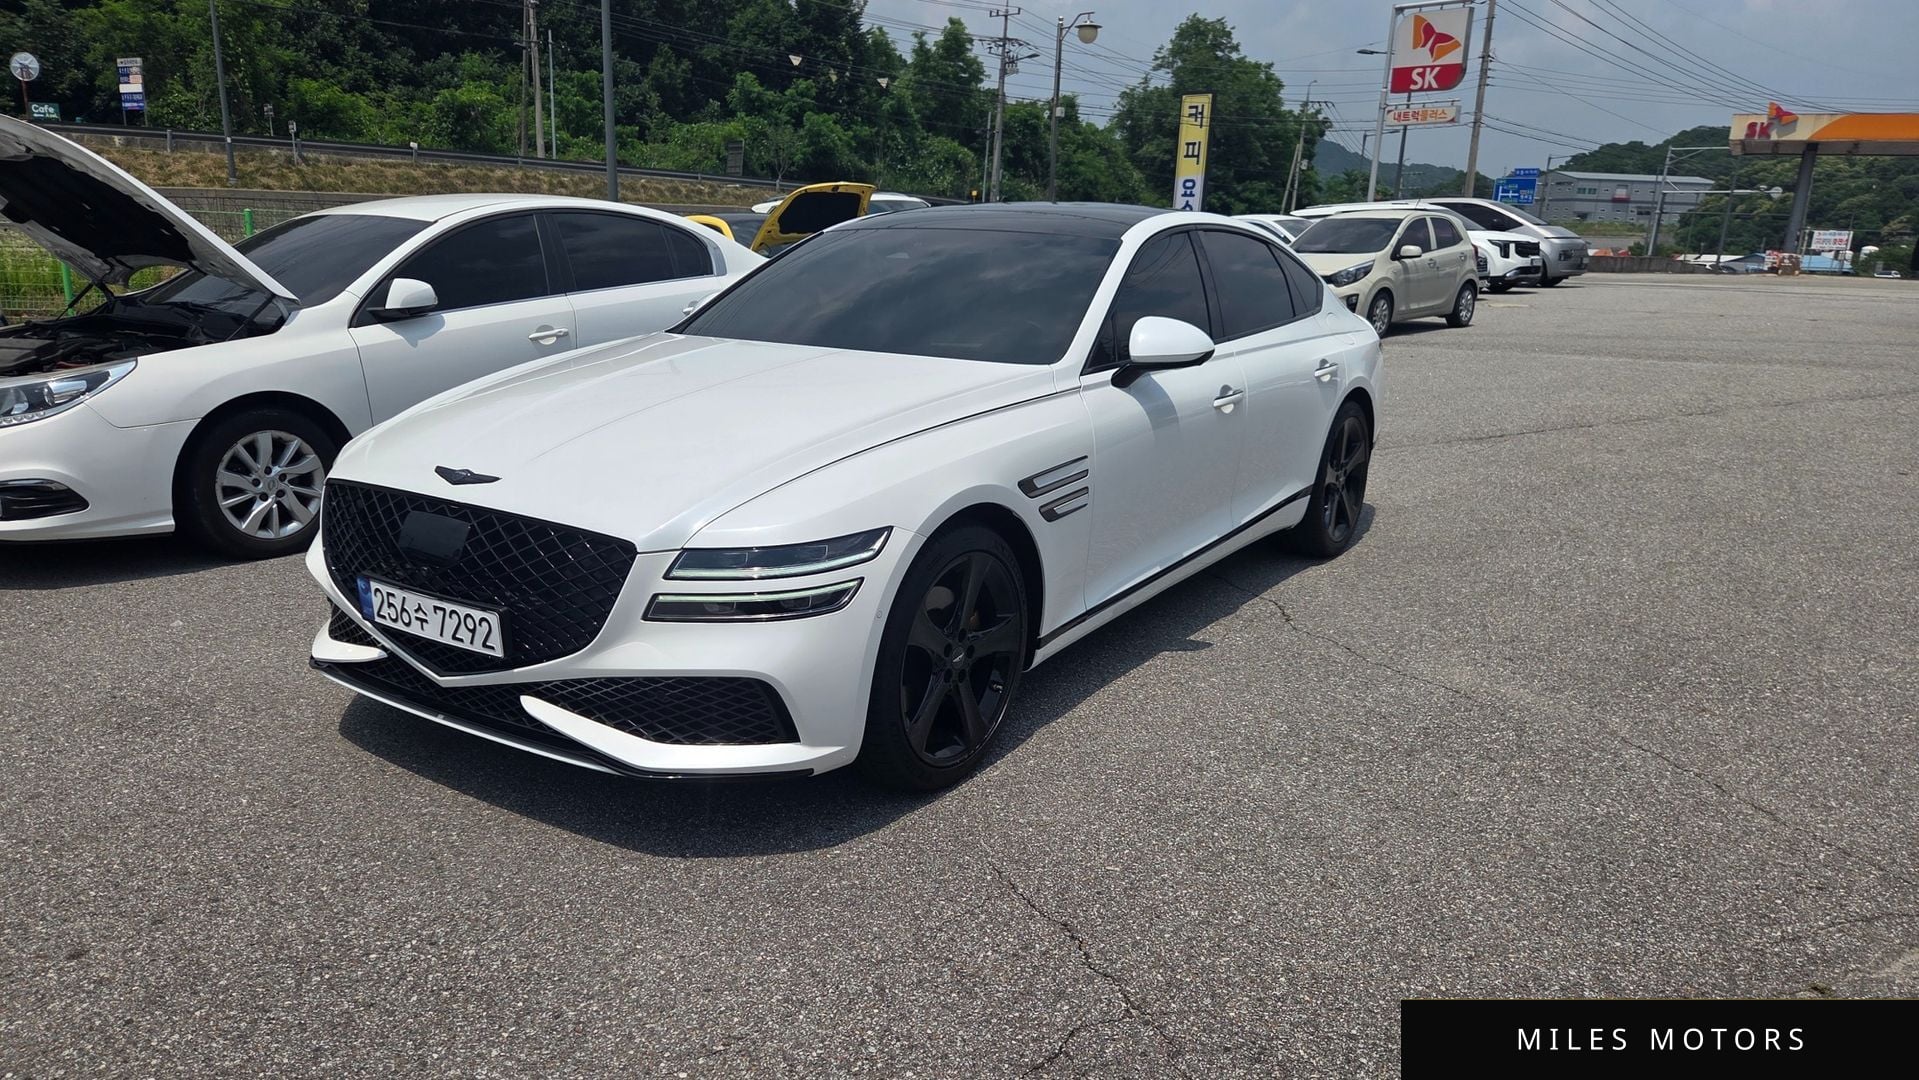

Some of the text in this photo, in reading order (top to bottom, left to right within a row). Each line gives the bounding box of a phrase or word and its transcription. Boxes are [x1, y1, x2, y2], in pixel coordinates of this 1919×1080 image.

[1409, 66, 1441, 90] SK
[31, 104, 55, 113] Cafe
[1183, 104, 1205, 165] 커피
[1745, 121, 1774, 139] SK
